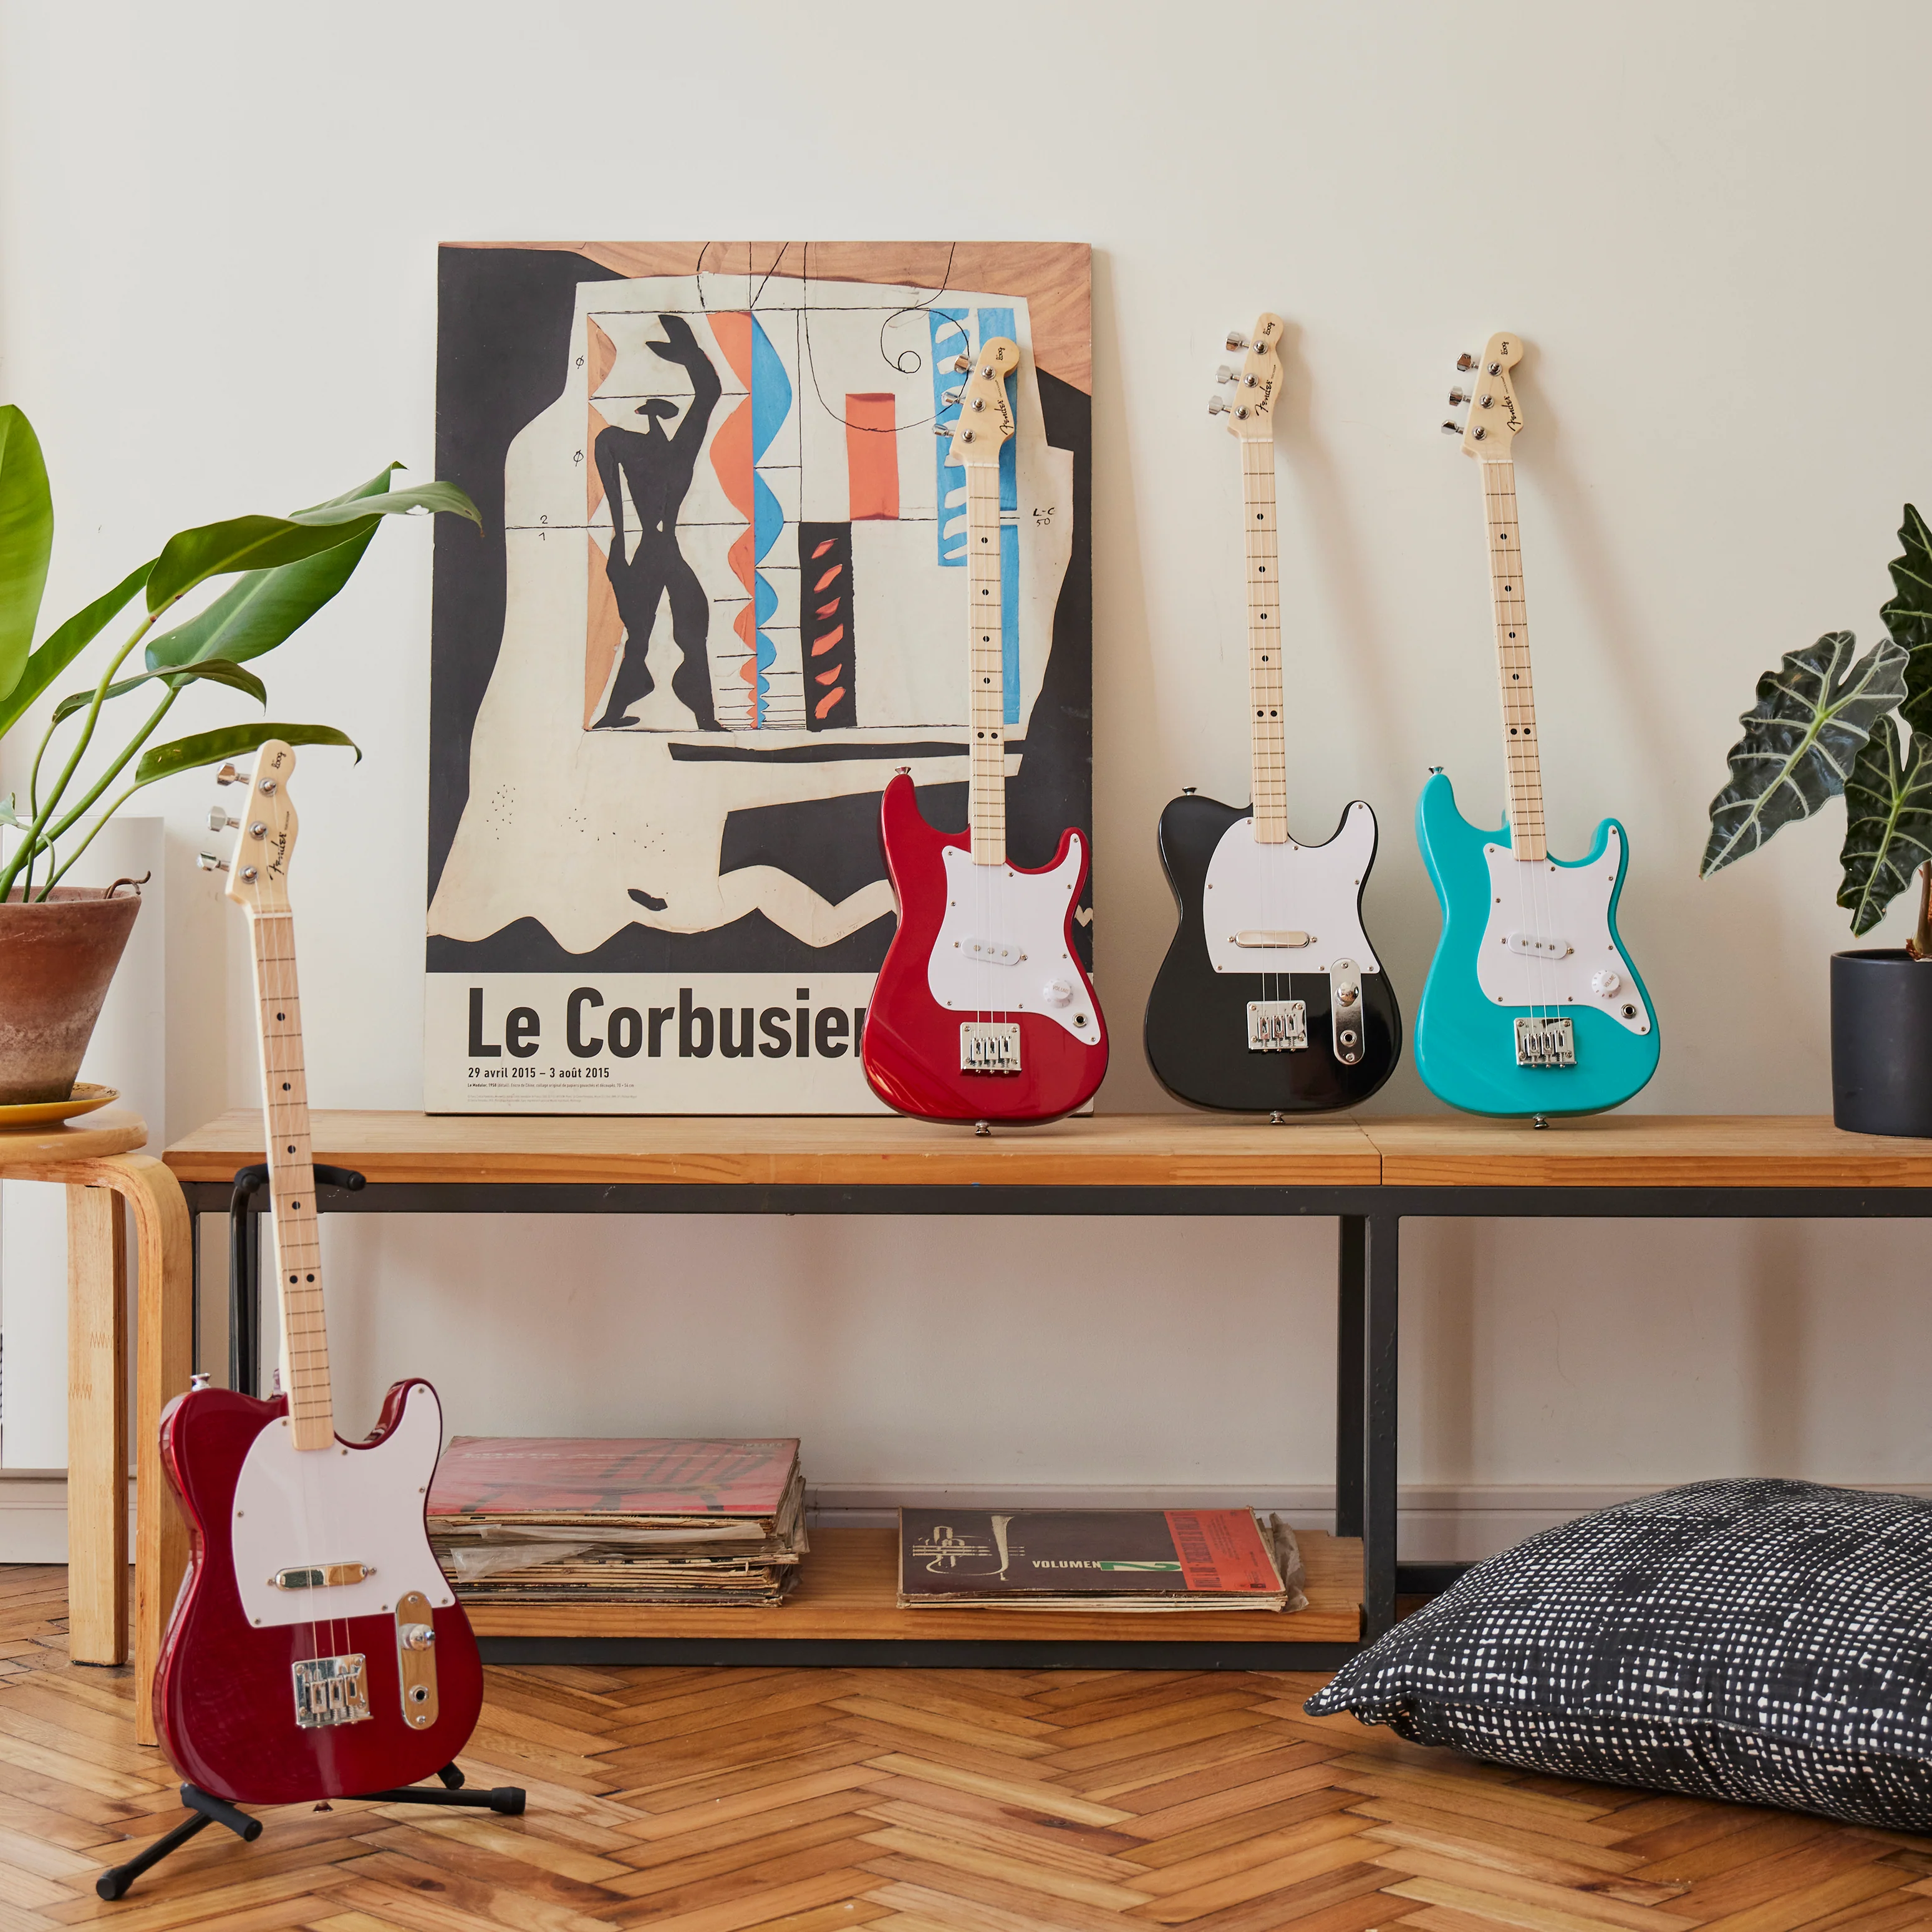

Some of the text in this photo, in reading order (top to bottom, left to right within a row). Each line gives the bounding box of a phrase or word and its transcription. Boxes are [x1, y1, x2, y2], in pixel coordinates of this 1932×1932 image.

[540, 515, 548, 524] 2
[1036, 518, 1051, 527] 50
[468, 987, 540, 1058] Le
[468, 1068, 480, 1078] 29
[484, 1067, 508, 1078] avril
[511, 1067, 536, 1078] 2015
[549, 1068, 555, 1078] 3
[559, 1067, 582, 1078] août
[586, 1067, 609, 1078] 2015
[1031, 1560, 1101, 1568] VOLUMEN
